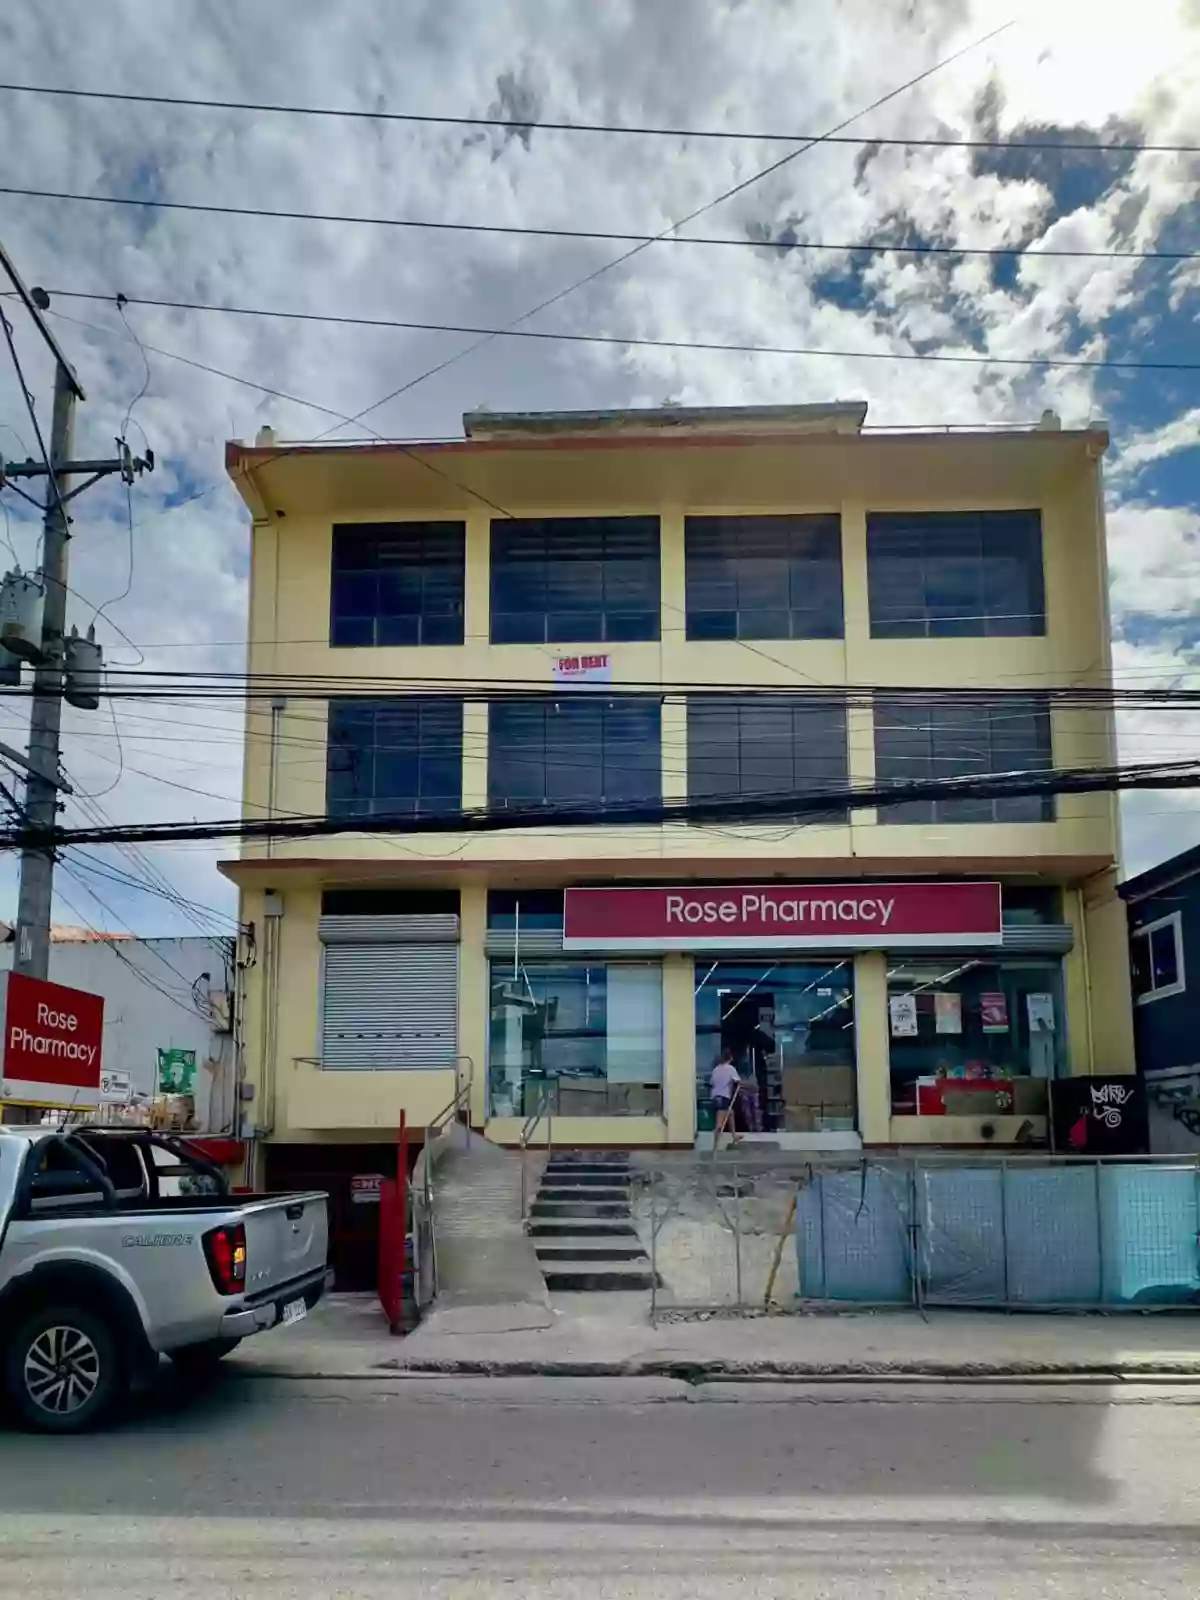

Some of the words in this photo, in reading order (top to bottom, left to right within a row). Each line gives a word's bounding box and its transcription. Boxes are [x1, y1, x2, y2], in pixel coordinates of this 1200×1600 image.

[559, 657, 579, 670] FOR
[581, 654, 607, 668] RENT
[37, 1002, 78, 1032] Rose
[10, 1026, 97, 1067] Pharmacy
[122, 1233, 195, 1247] CALIBRE
